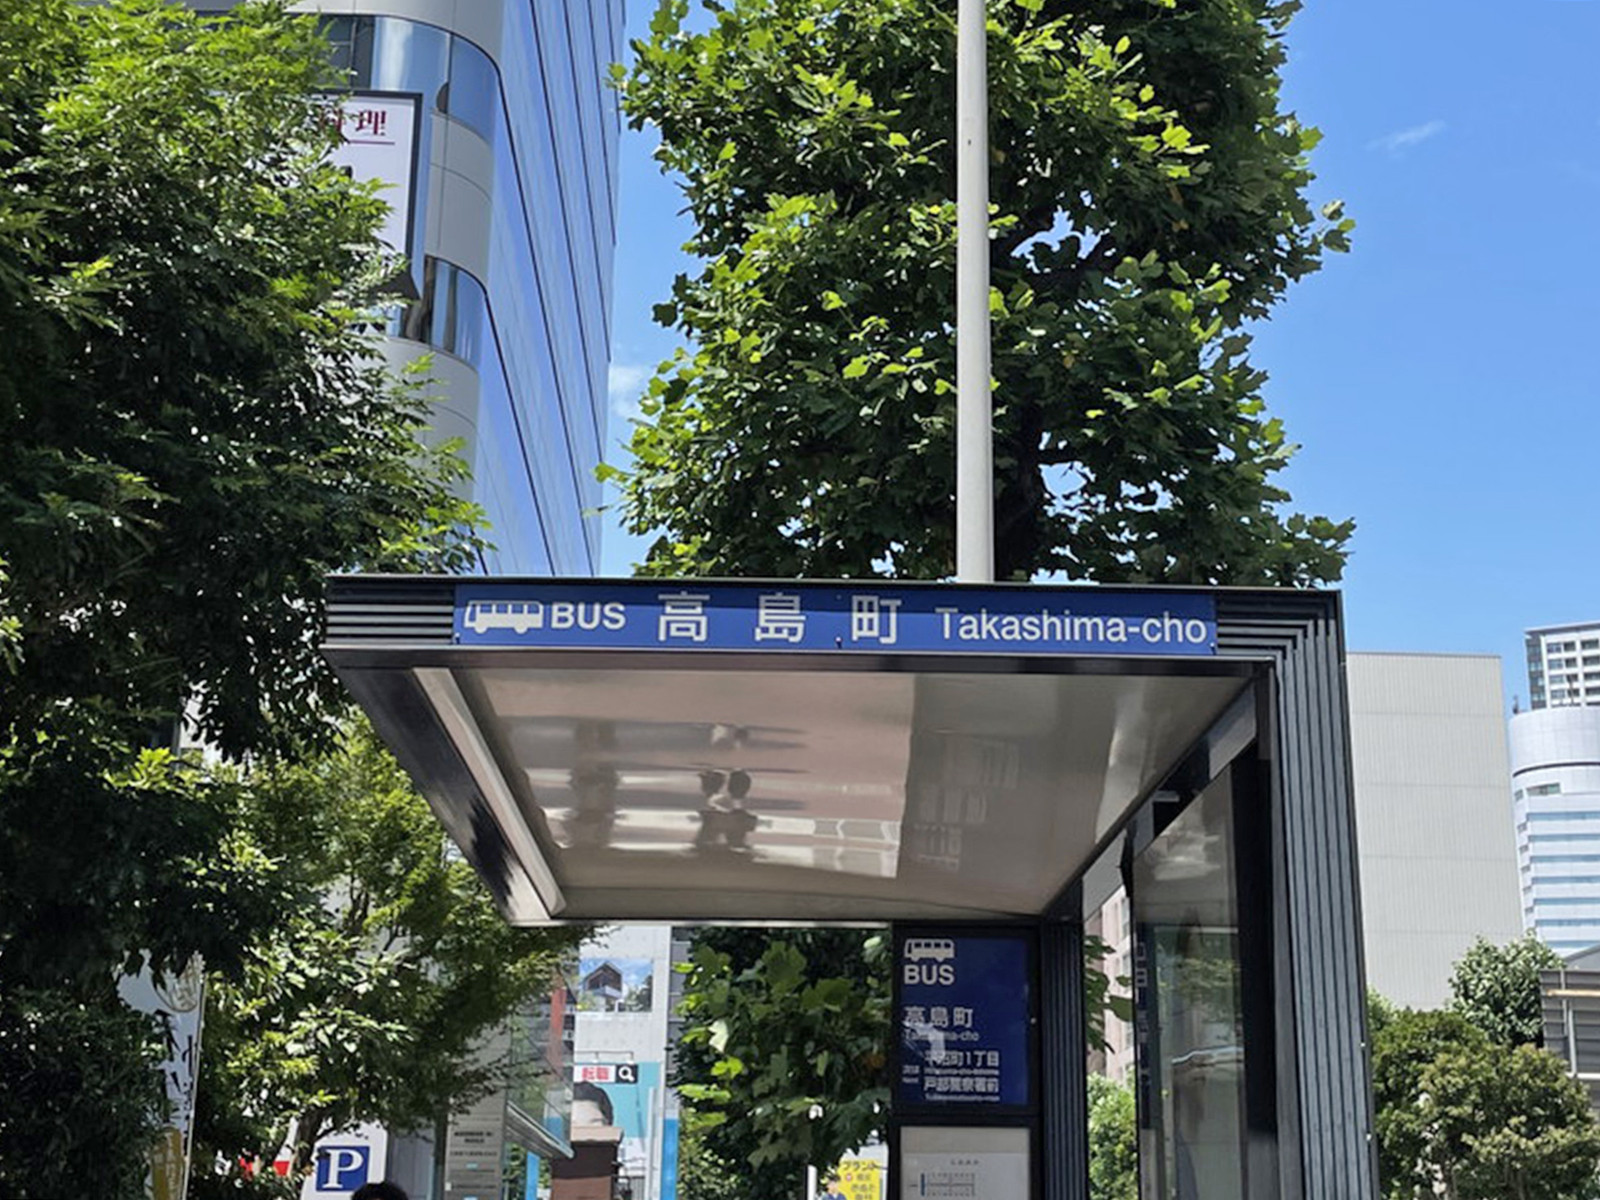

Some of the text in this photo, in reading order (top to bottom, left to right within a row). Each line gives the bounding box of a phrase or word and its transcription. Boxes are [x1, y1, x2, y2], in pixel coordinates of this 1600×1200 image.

[550, 591, 1207, 645] BUS 高島町 Takashima-cho
[904, 964, 955, 985] BUS
[903, 1005, 974, 1028] 高島町
[321, 1148, 364, 1189] P
